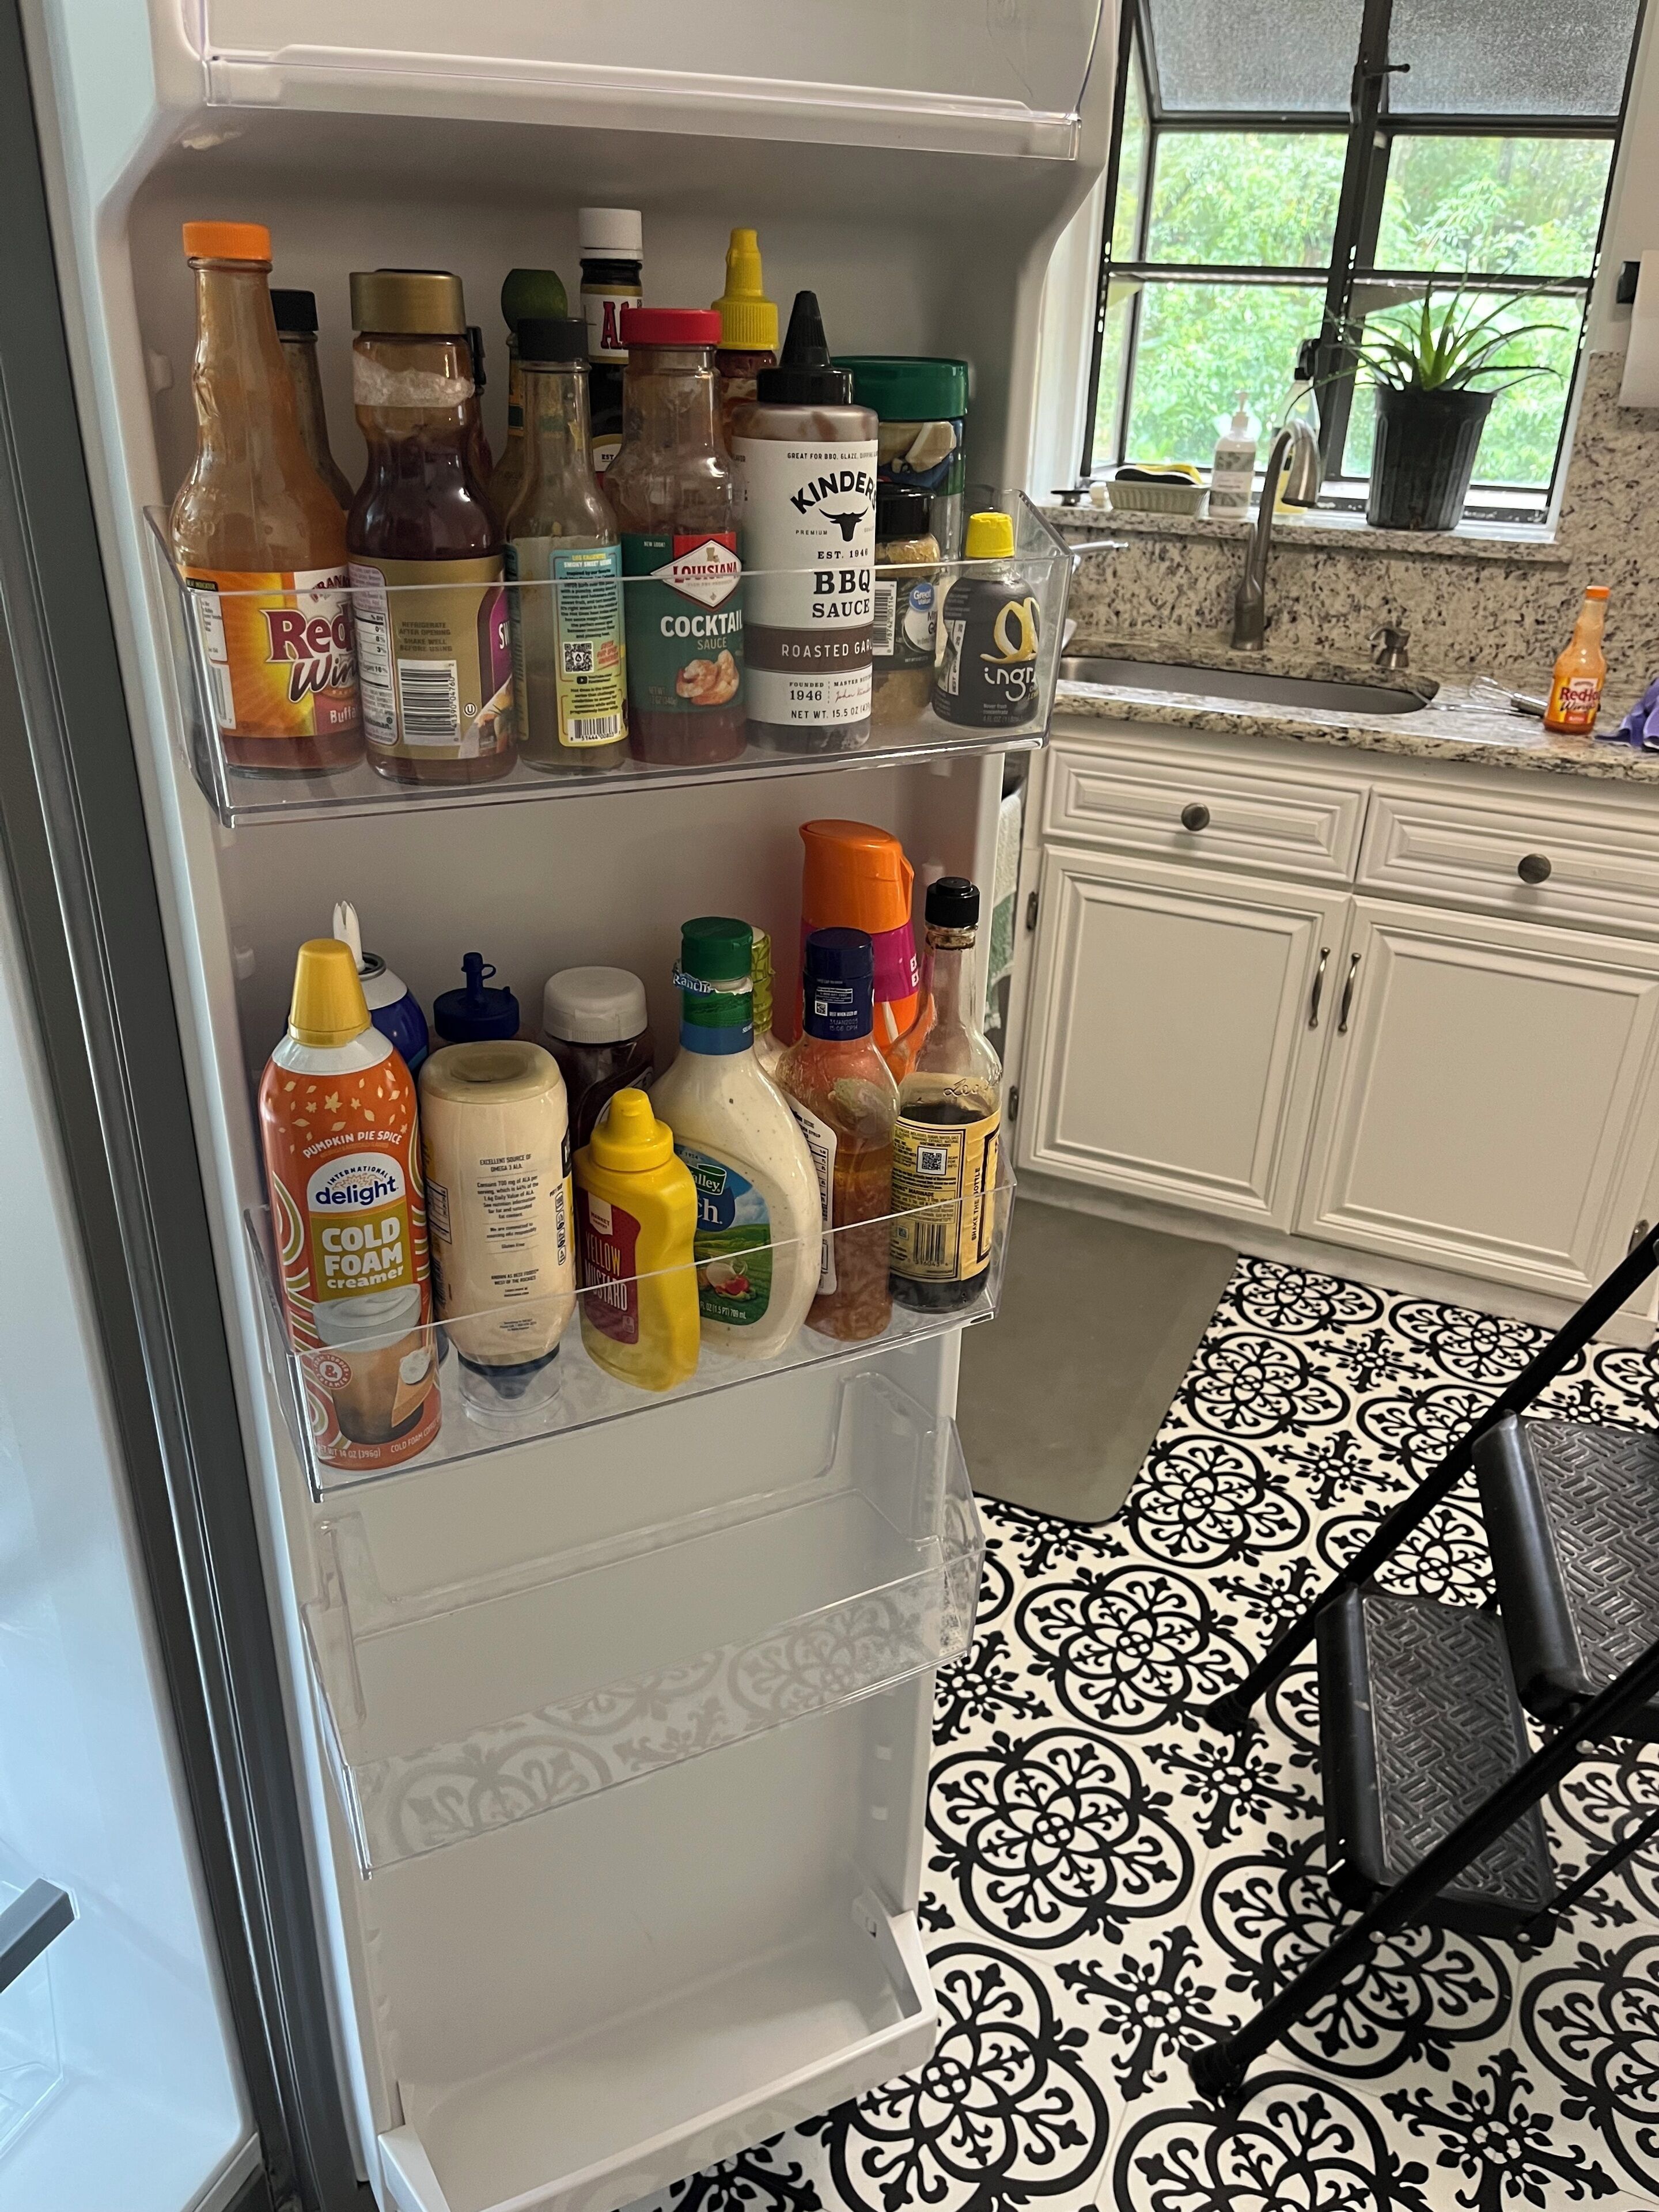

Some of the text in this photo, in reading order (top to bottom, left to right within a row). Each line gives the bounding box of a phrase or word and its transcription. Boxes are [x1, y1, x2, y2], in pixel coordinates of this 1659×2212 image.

[850, 548, 868, 558] 1946
[673, 562, 738, 583] LOUISIANA
[813, 569, 870, 594] BBQ
[914, 589, 931, 601] Great
[812, 599, 870, 618] SAUCE
[660, 609, 743, 638] COCKTAIL
[698, 637, 727, 650] SAUCE
[782, 643, 849, 658] ROASTED
[834, 679, 858, 687] MASTER
[790, 690, 822, 700] 1946
[791, 710, 809, 718] NET
[832, 709, 848, 718] 15.5
[851, 706, 858, 715] OZ
[303, 1133, 354, 1158] PUMPKIN
[358, 1131, 376, 1141] PIE
[377, 1131, 402, 1145] SPICE
[506, 1155, 525, 1163] SOURCE
[327, 1166, 389, 1185] INTERNATIONAL
[692, 1171, 720, 1192] alley
[316, 1176, 397, 1206] delight
[908, 1188, 934, 1198] MARINADE
[591, 1211, 610, 1227] MARKET
[322, 1217, 400, 1252] COLD
[324, 1241, 403, 1276] FOAM
[585, 1230, 621, 1277] YELLOW
[327, 1265, 403, 1289] creamer
[585, 1258, 628, 1312] MUSTARD
[391, 1433, 423, 1453] COLD FOAM
[358, 1447, 381, 1459] (396g)
